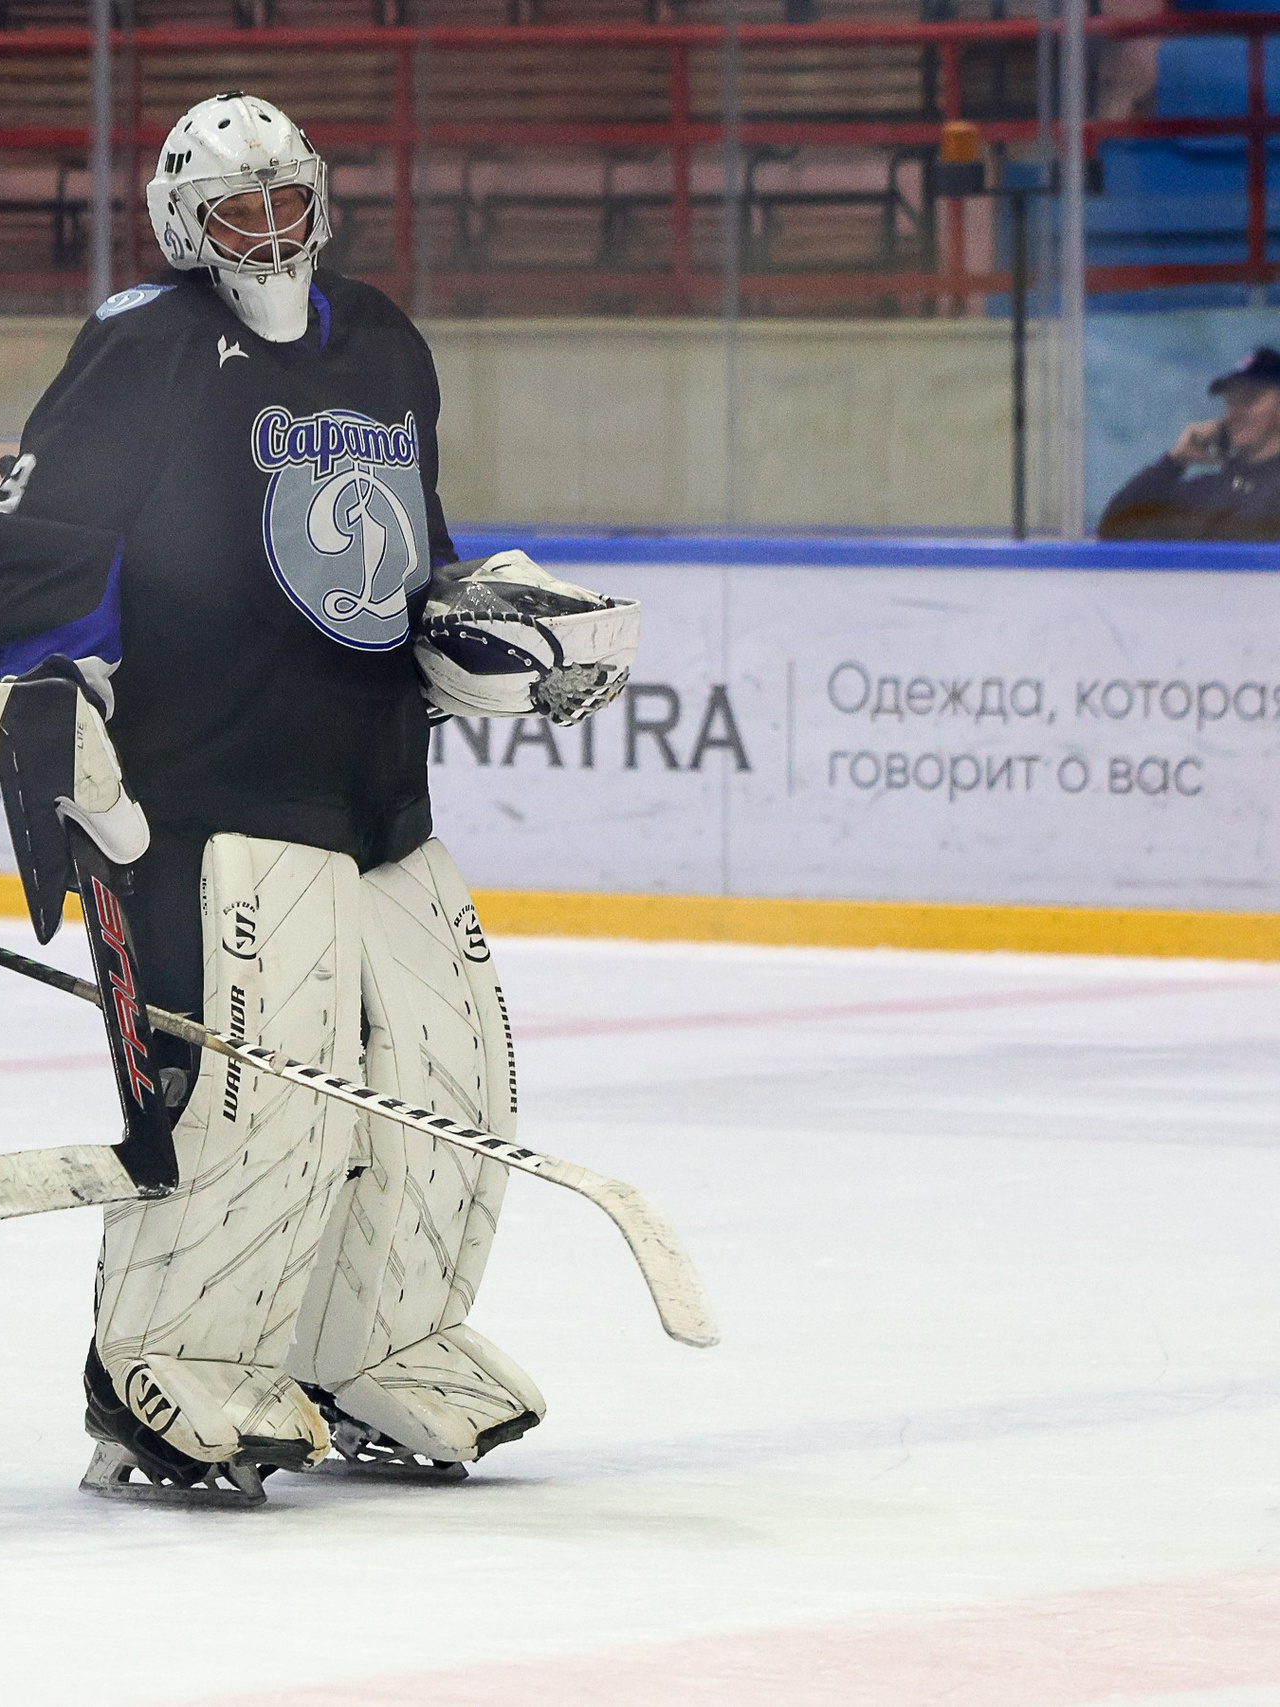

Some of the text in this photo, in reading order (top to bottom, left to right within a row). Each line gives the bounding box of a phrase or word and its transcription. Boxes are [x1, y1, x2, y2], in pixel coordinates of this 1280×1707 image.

[827, 660, 1058, 725] Одежда,
[828, 750, 1041, 803] говорит
[1107, 756, 1204, 796] вас
[91, 875, 155, 1110] TRUE
[223, 984, 245, 1122] WARIOR
